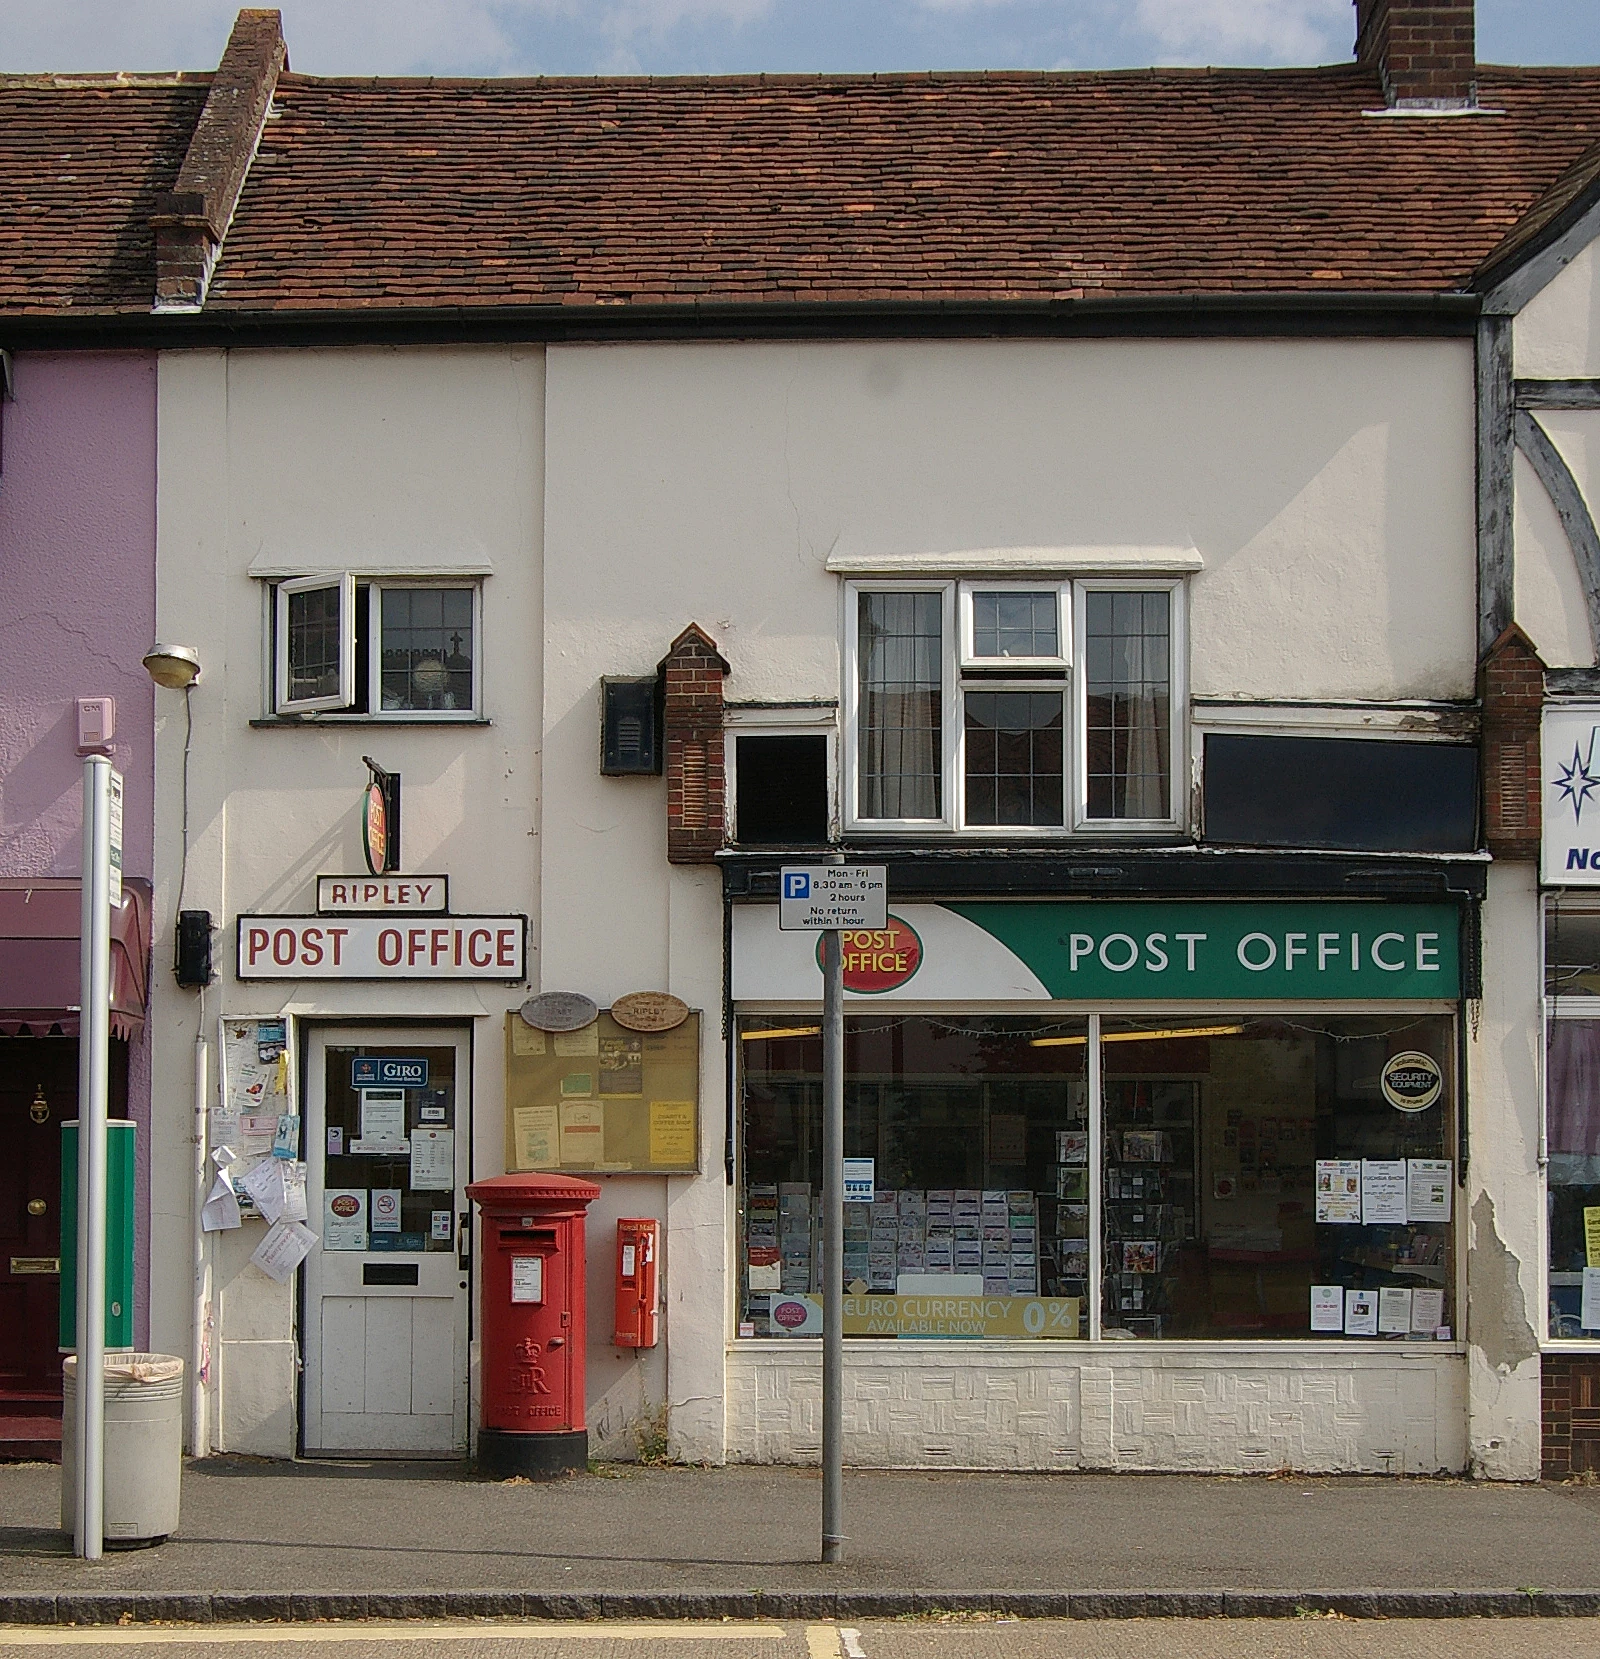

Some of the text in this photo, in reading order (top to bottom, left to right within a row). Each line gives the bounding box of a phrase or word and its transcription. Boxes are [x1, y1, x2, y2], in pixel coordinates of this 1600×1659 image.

[790, 875, 807, 897] P
[827, 869, 848, 878] Mon
[855, 869, 869, 878] Fri
[812, 881, 837, 889] 8.30
[859, 881, 867, 889] 6
[868, 882, 883, 890] pm
[331, 884, 433, 904] RIPLEY
[838, 893, 866, 902] hours
[809, 906, 858, 915] No return
[802, 916, 865, 925] within 1 hour
[842, 930, 900, 950] POST
[248, 928, 515, 968] POST OFFICE
[1069, 932, 1440, 972] POST OFFICE
[383, 1063, 422, 1077] GIRO
[1390, 1072, 1434, 1081] SECURITY
[780, 1306, 801, 1314] POST
[902, 1299, 1013, 1319] CURRENCY
[777, 1314, 803, 1322] OFFICE
[866, 1319, 987, 1334] AVAILABLE NOW
